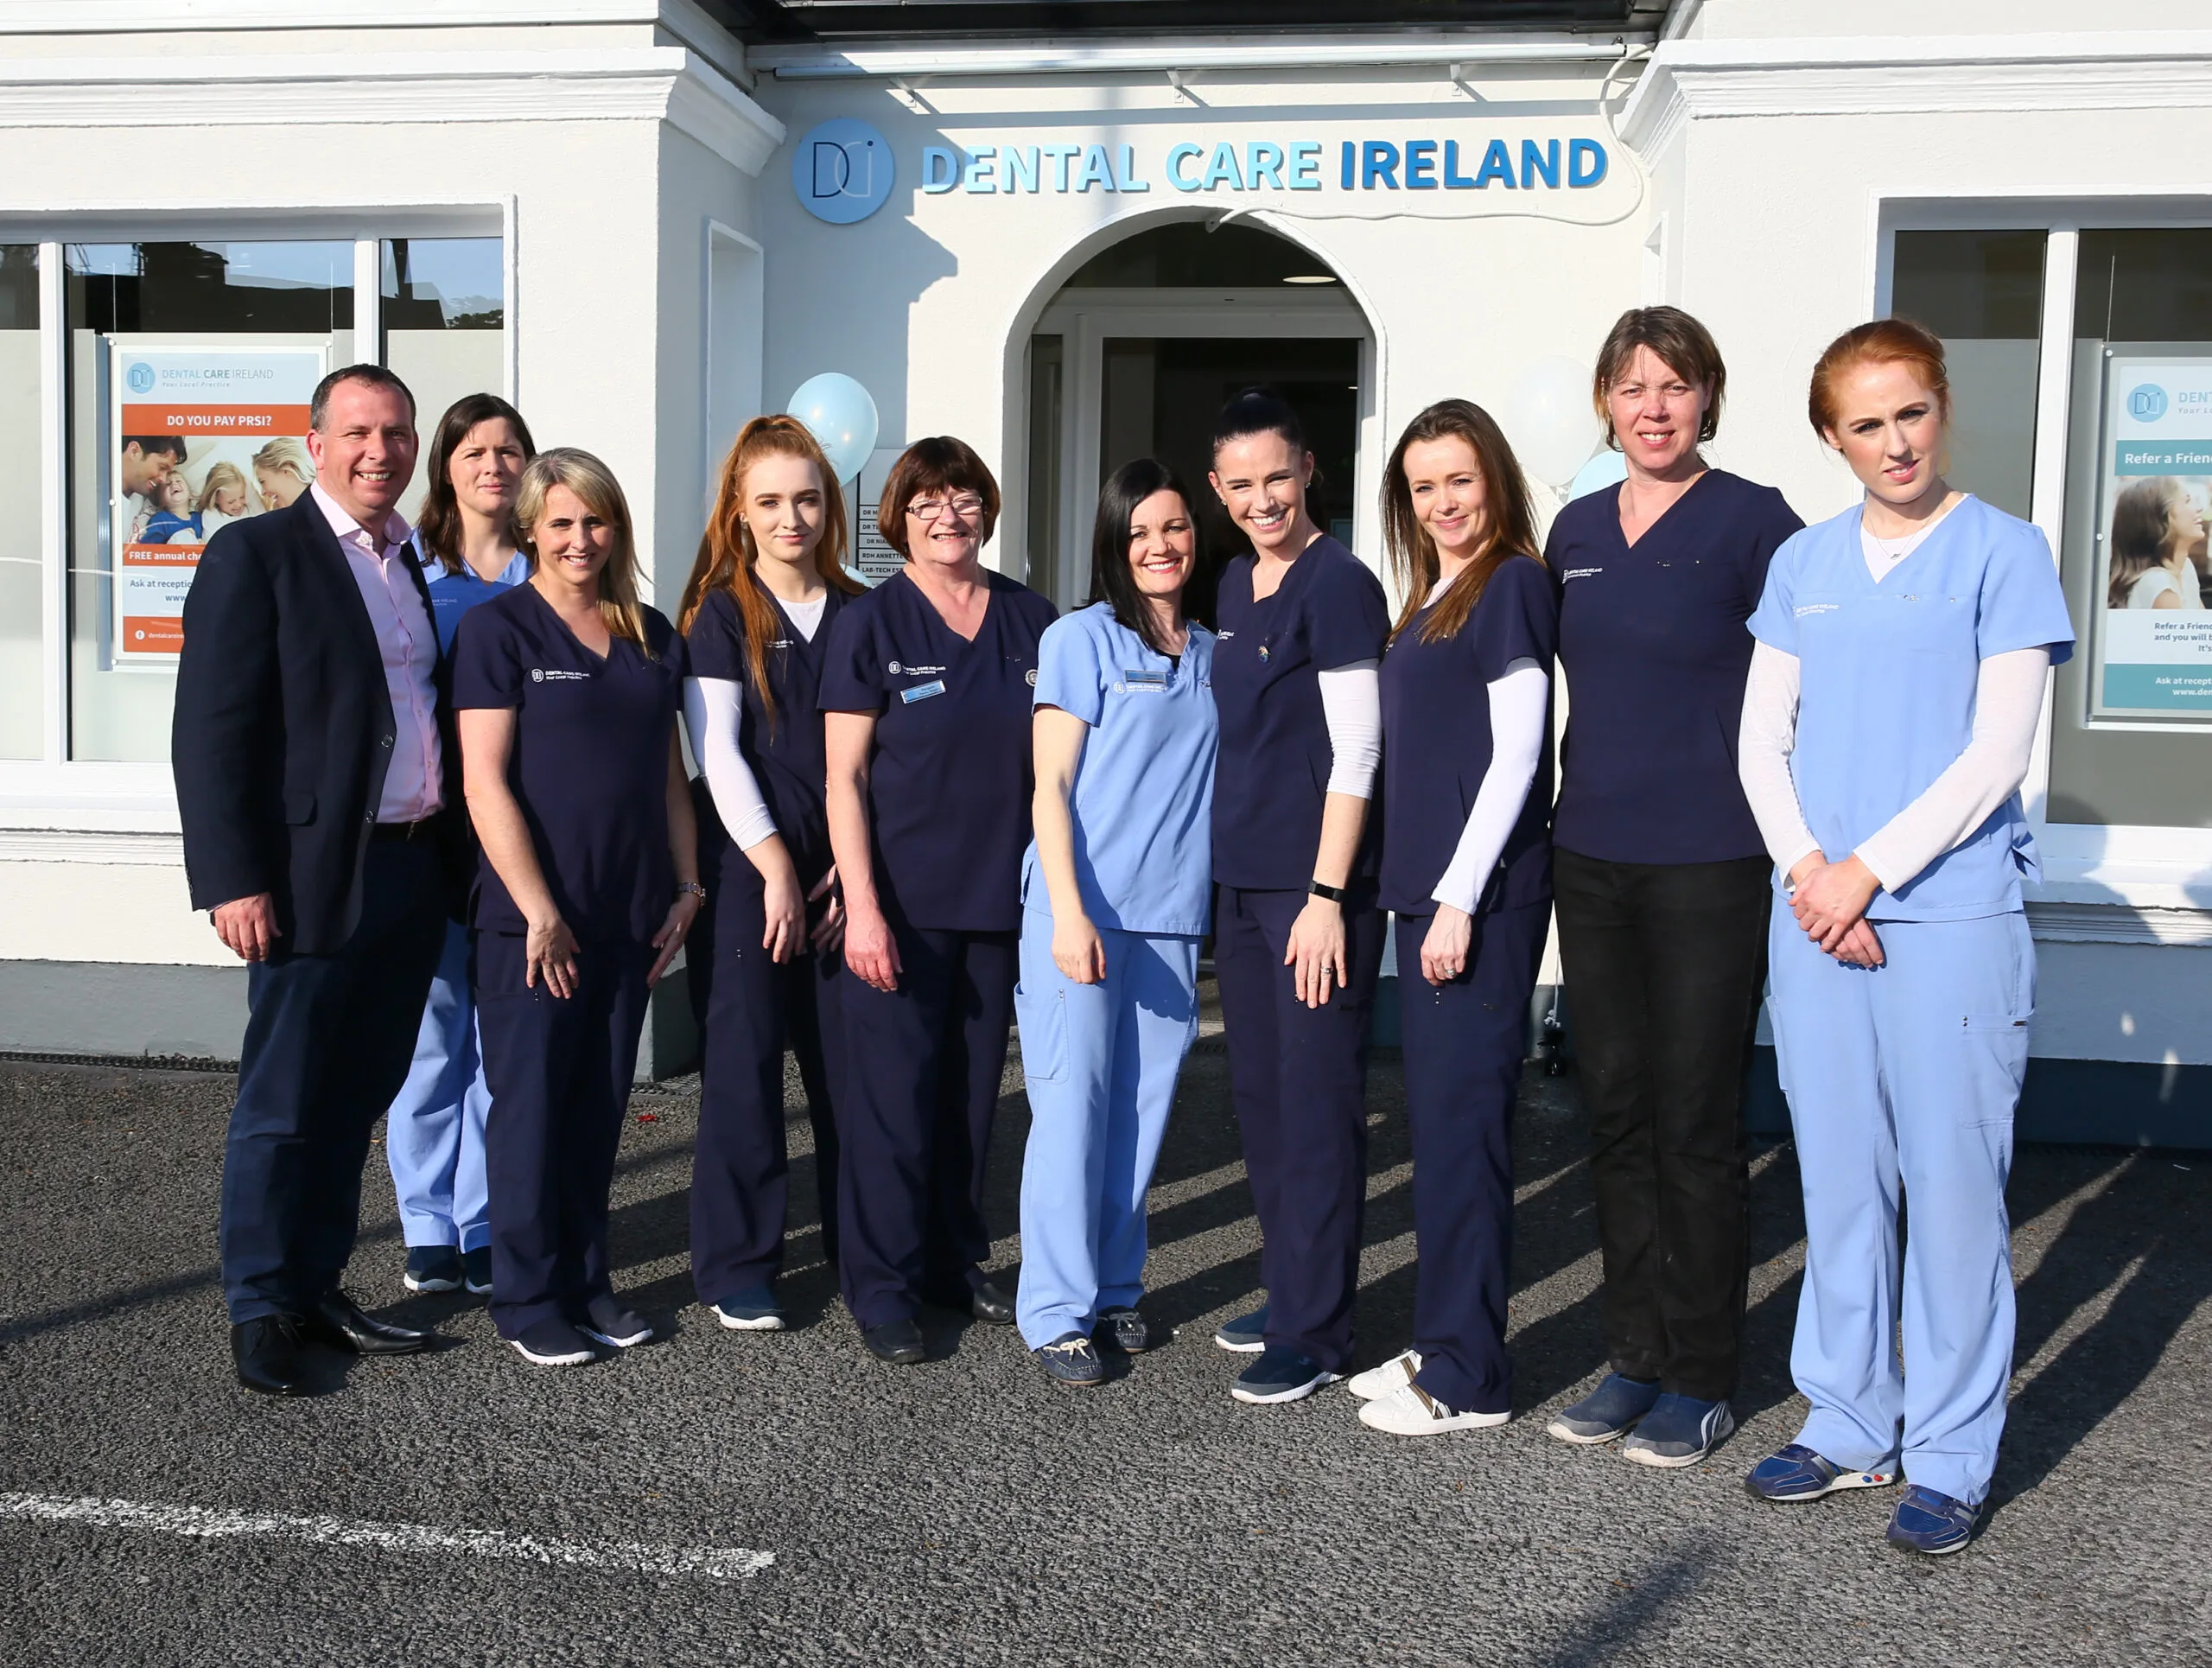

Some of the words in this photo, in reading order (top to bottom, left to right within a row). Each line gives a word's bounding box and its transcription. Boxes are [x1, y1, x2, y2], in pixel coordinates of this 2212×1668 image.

[922, 143, 1151, 194] DENTAL
[1166, 141, 1322, 192] CARE
[1341, 138, 1609, 190] IRELAND
[162, 369, 201, 379] DENTAL
[203, 369, 230, 379] CARE
[232, 369, 274, 379] IRELAND
[167, 416, 185, 426] DO
[187, 416, 212, 426] YOU
[213, 416, 236, 426] PAY
[238, 416, 272, 426] PRSI?
[2125, 453, 2162, 464] Refer
[2164, 455, 2172, 464] a
[2176, 452, 2212, 464] Frien
[129, 551, 152, 560] FREE
[154, 551, 186, 560] annual
